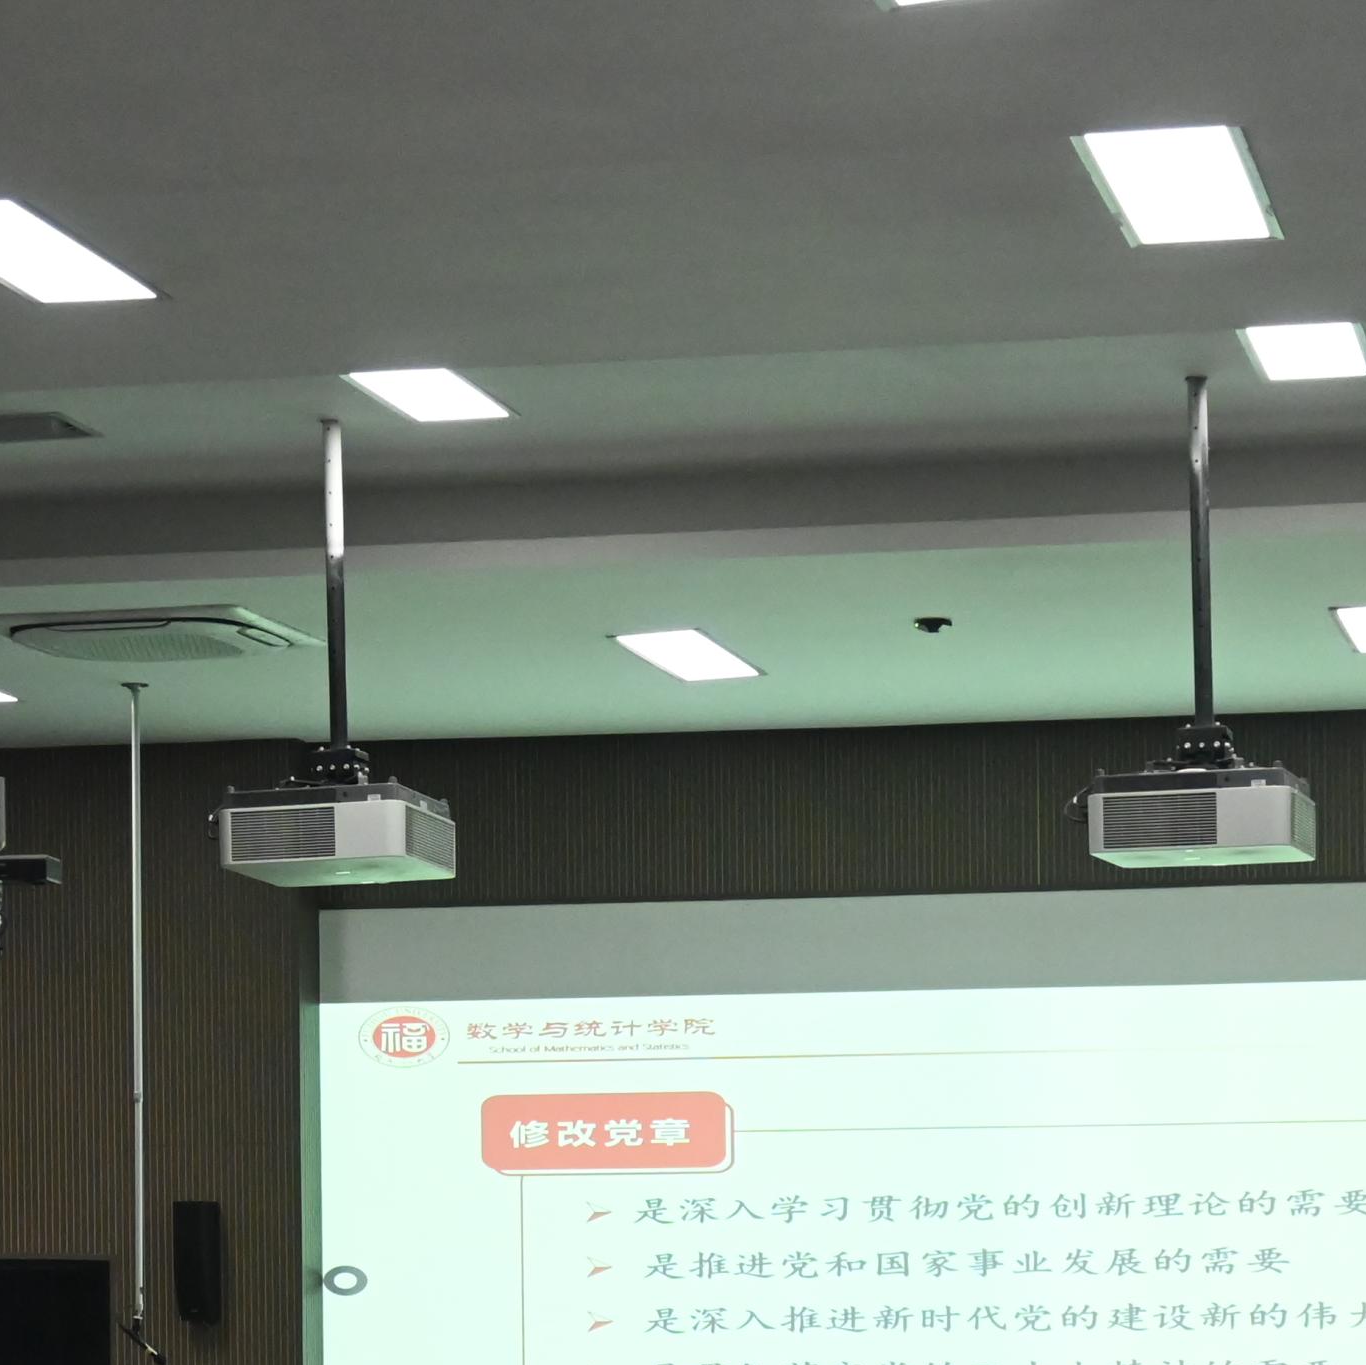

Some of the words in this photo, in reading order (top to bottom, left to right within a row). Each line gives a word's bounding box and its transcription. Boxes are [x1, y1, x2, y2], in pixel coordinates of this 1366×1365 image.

[466, 1018, 716, 1041] 数学与统计学院
[489, 1045, 527, 1054] School
[544, 1043, 615, 1053] Mathematics
[617, 1043, 640, 1051] and
[509, 1117, 691, 1149] 修改党章
[644, 1247, 1291, 1280] 是推进党和国家事业发展的需要
